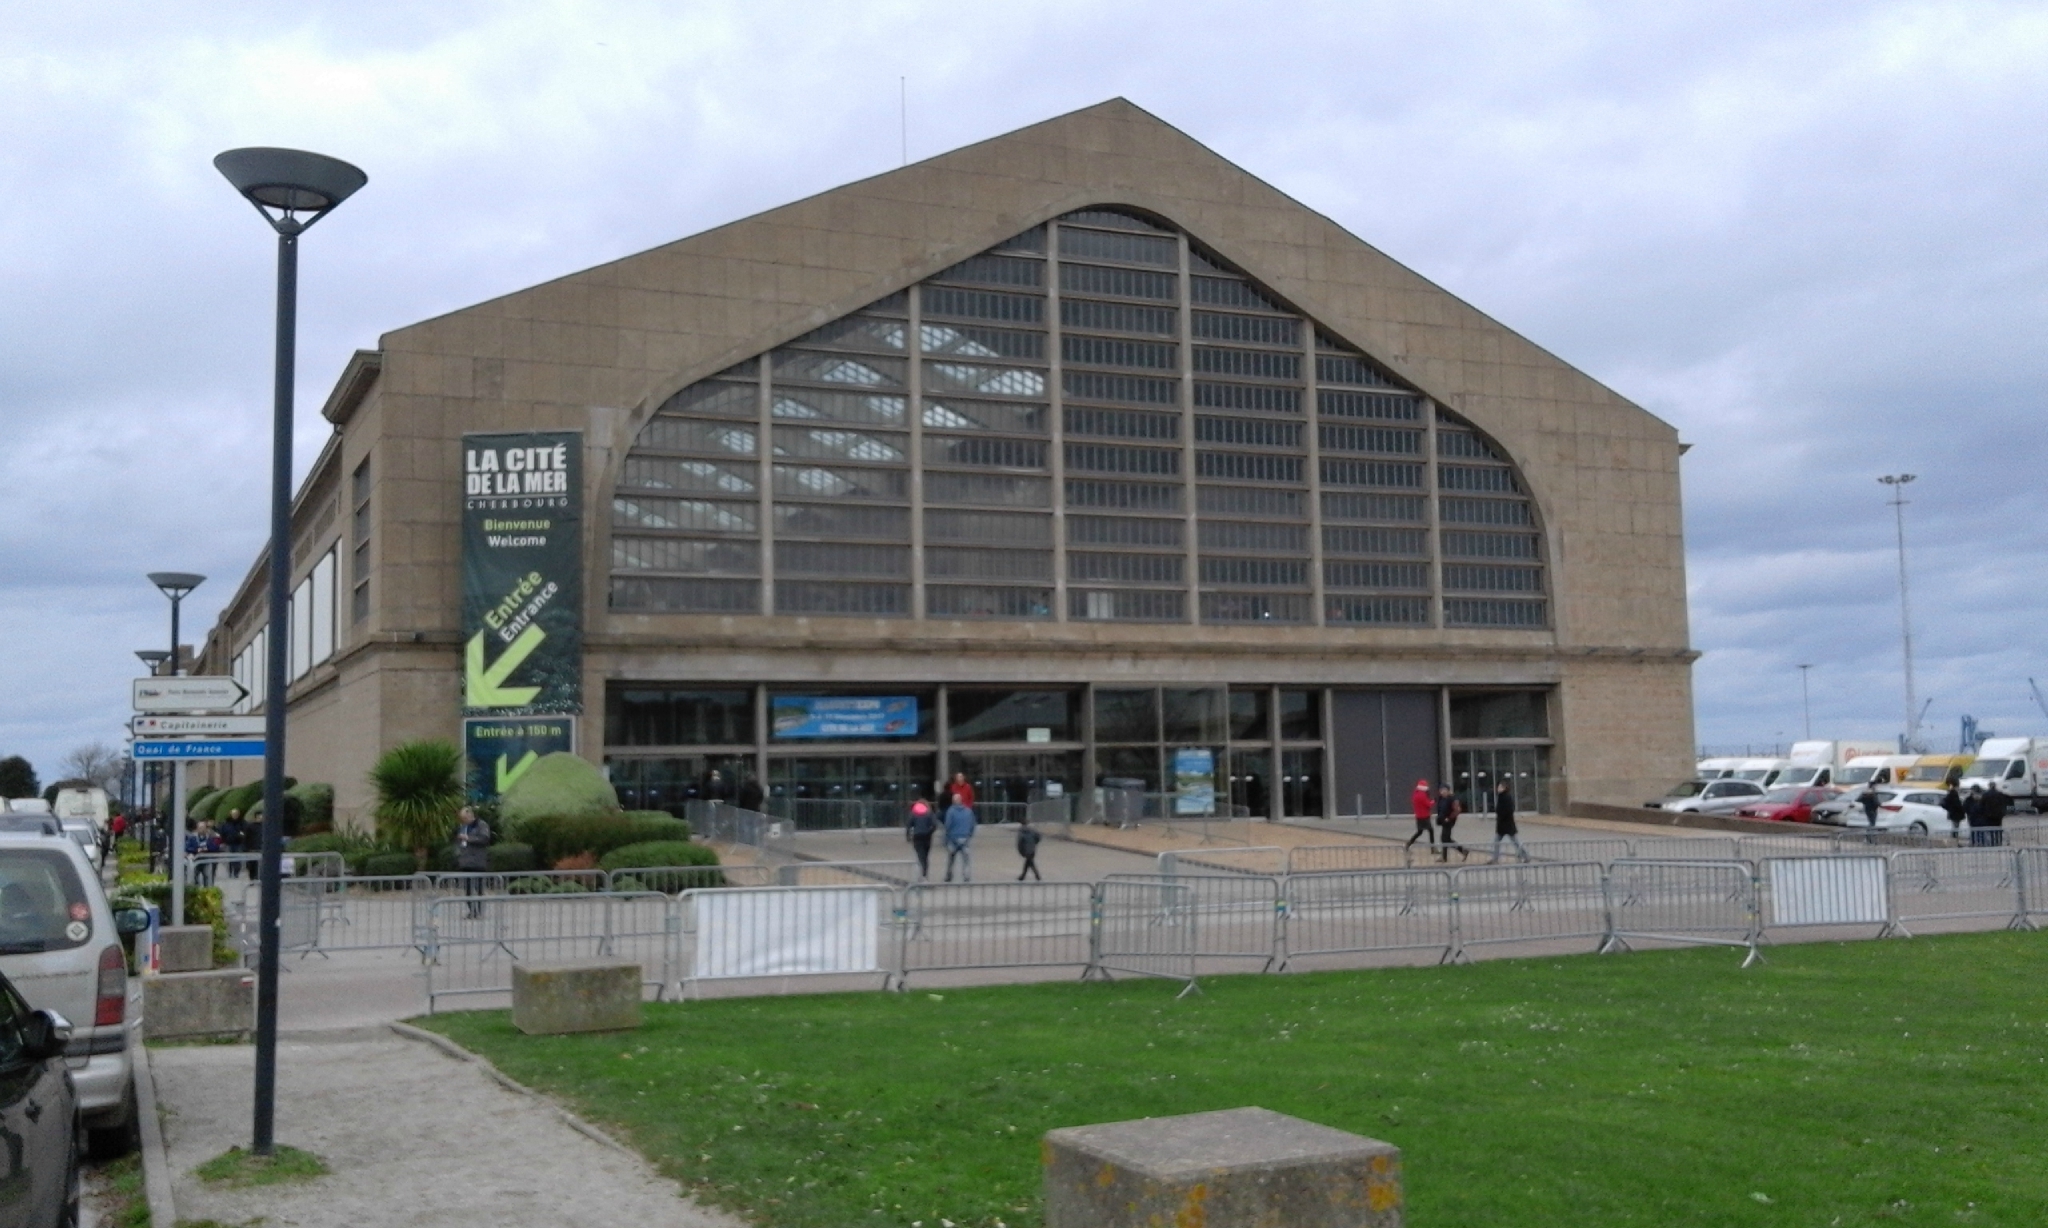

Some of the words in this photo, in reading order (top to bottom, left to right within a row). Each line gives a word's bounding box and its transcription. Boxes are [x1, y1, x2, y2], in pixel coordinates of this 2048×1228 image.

[467, 449, 499, 472] LA
[506, 442, 567, 471] CITÉ
[467, 473, 492, 495] DE
[496, 472, 520, 494] LA
[524, 471, 567, 493] MER
[467, 498, 568, 510] CHERBOURG
[484, 519, 551, 531] Bienvenue
[488, 535, 547, 547] Welcome
[484, 570, 543, 630] Entrée
[499, 580, 559, 643] Entrance
[160, 721, 228, 731] Capitainerie
[475, 725, 514, 738] Entrée
[138, 745, 163, 754] Quai
[168, 744, 181, 753] de
[186, 744, 222, 753] France
